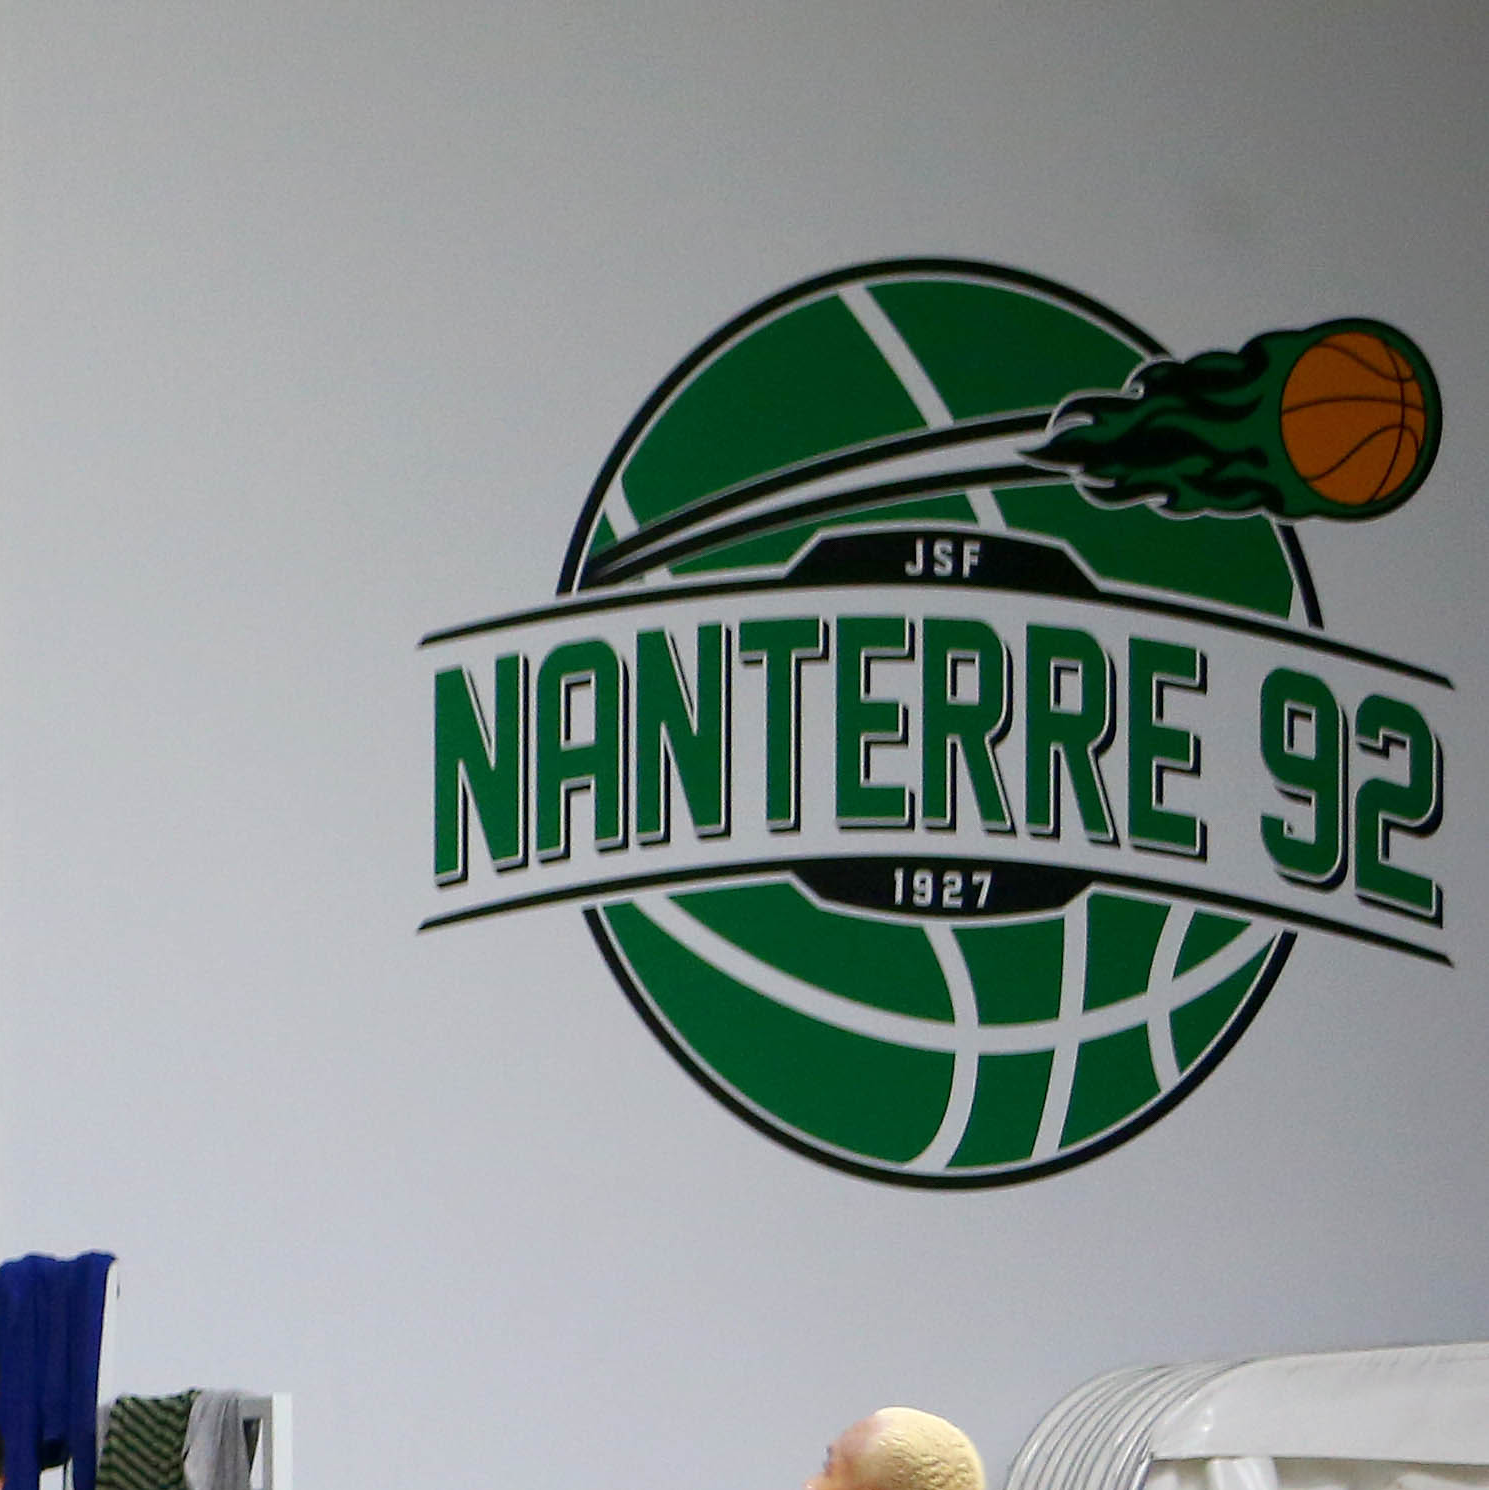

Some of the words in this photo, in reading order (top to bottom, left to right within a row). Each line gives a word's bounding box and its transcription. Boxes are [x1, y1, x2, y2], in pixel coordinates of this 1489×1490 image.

[905, 538, 981, 578] JSF
[432, 615, 1209, 885] NANTERRE
[1258, 664, 1445, 932] 92
[893, 869, 994, 911] 1927
